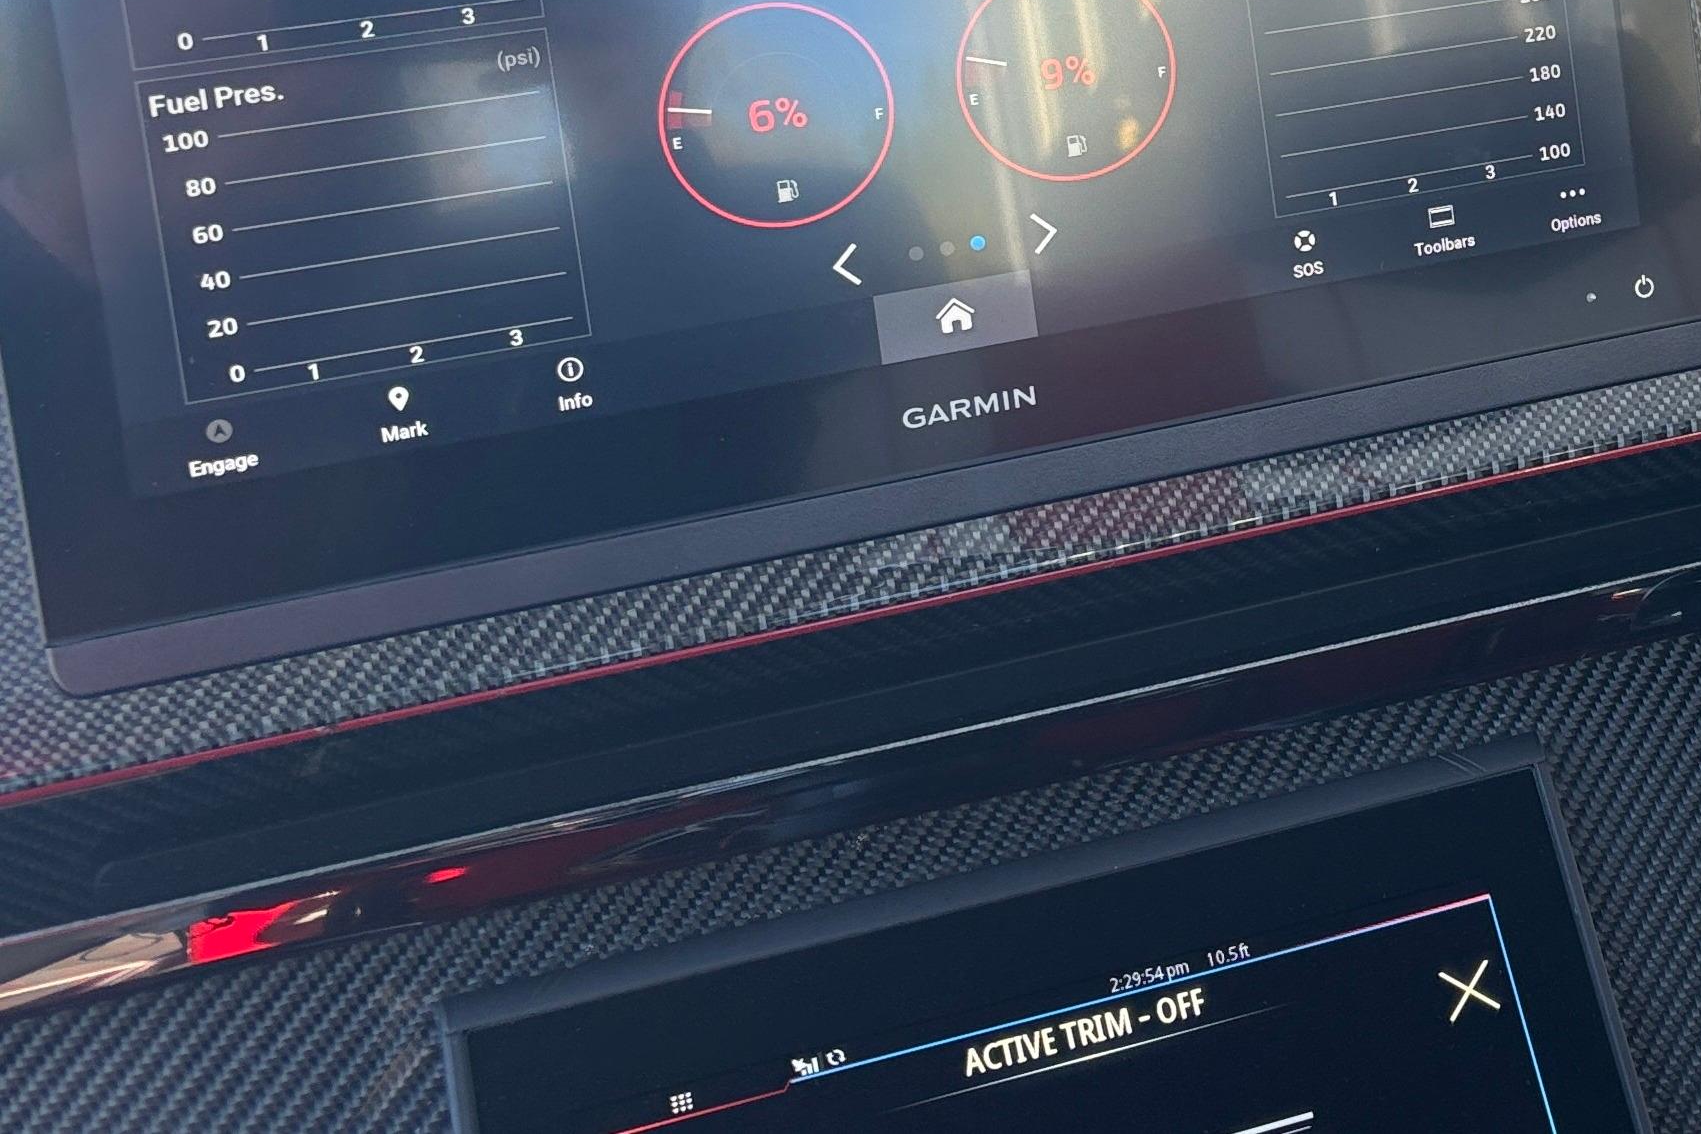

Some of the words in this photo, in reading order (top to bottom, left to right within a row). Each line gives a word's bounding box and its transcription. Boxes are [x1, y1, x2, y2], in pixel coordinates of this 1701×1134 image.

[497, 46, 540, 72] (psi)
[1041, 55, 1096, 90] 9%
[148, 90, 208, 117] Fuel
[215, 84, 284, 109] Pres.
[748, 97, 808, 134] 6%
[1550, 212, 1601, 234] Options
[1415, 234, 1475, 257] Toolbars
[1293, 261, 1324, 278] SOS
[558, 392, 593, 413] Info
[902, 385, 1037, 429] GARMIN
[381, 421, 428, 444] Mark
[188, 452, 258, 478] Engage
[1109, 966, 1165, 993] 2:29:54
[1167, 961, 1189, 982] pm
[1207, 943, 1250, 967] 10.5ft
[966, 1027, 1057, 1077] ACTIVE
[1060, 1008, 1133, 1050] TRIM
[1156, 988, 1205, 1024] OFF
